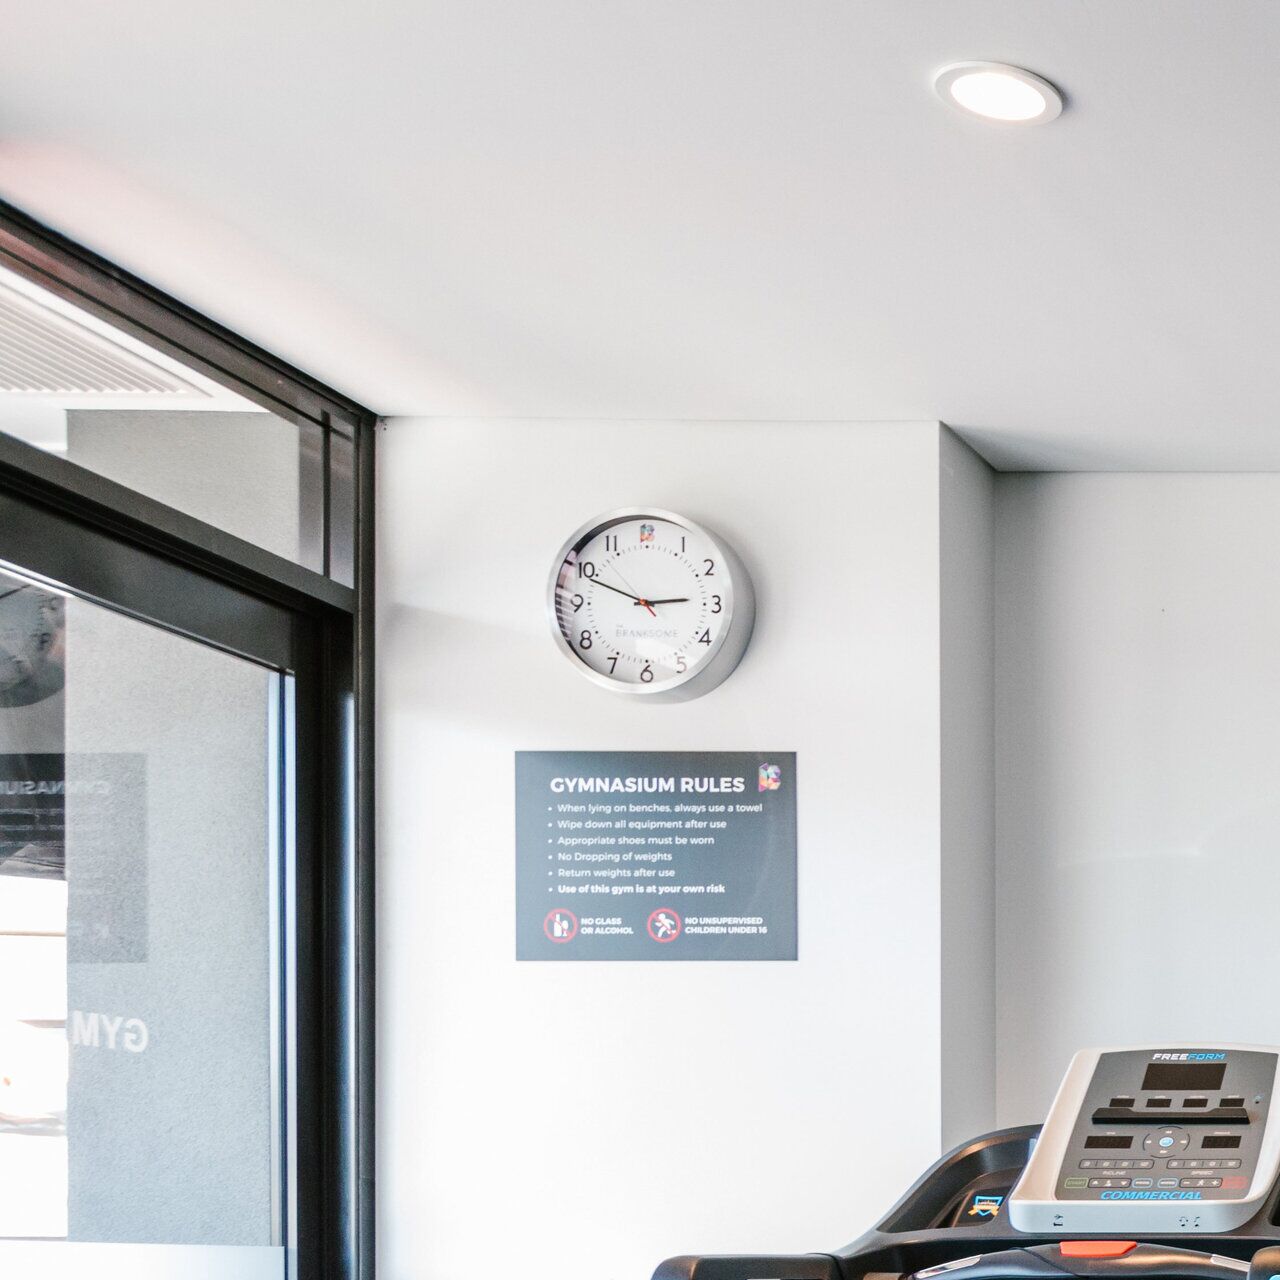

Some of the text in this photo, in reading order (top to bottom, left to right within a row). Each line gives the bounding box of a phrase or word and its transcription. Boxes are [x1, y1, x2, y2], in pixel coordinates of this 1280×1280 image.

[605, 535, 618, 551] 11
[681, 536, 686, 552] 1
[578, 562, 595, 578] 10
[703, 559, 715, 576] 2
[571, 594, 584, 613] 9
[711, 595, 722, 613] 3
[579, 630, 593, 650] 8
[699, 628, 712, 646] 4
[607, 657, 618, 674] 7
[676, 656, 687, 673] 5
[640, 665, 653, 683] 6
[549, 776, 746, 793] GYMNASIUM RULES
[557, 803, 587, 812] When
[588, 803, 612, 815] lying
[629, 803, 673, 815] benches,
[674, 803, 707, 815] always
[736, 803, 764, 812] towel
[557, 819, 728, 831] Wipe down all equipment after use
[557, 835, 715, 848] Appropriate shoes must be worn
[557, 852, 673, 864] No Dropping of weights
[557, 868, 676, 880] Return weights after use
[557, 884, 726, 896] Use of this gym is at your own risk
[581, 917, 622, 925] NO GLASS
[685, 916, 763, 925] NO UNSUPERVISED
[580, 926, 634, 935] OR ALCOHOL
[685, 926, 768, 934] CHILDREN UNDER 16
[1152, 1052, 1228, 1061] FREEFORM
[1100, 1190, 1203, 1200] COMMERCIAL
